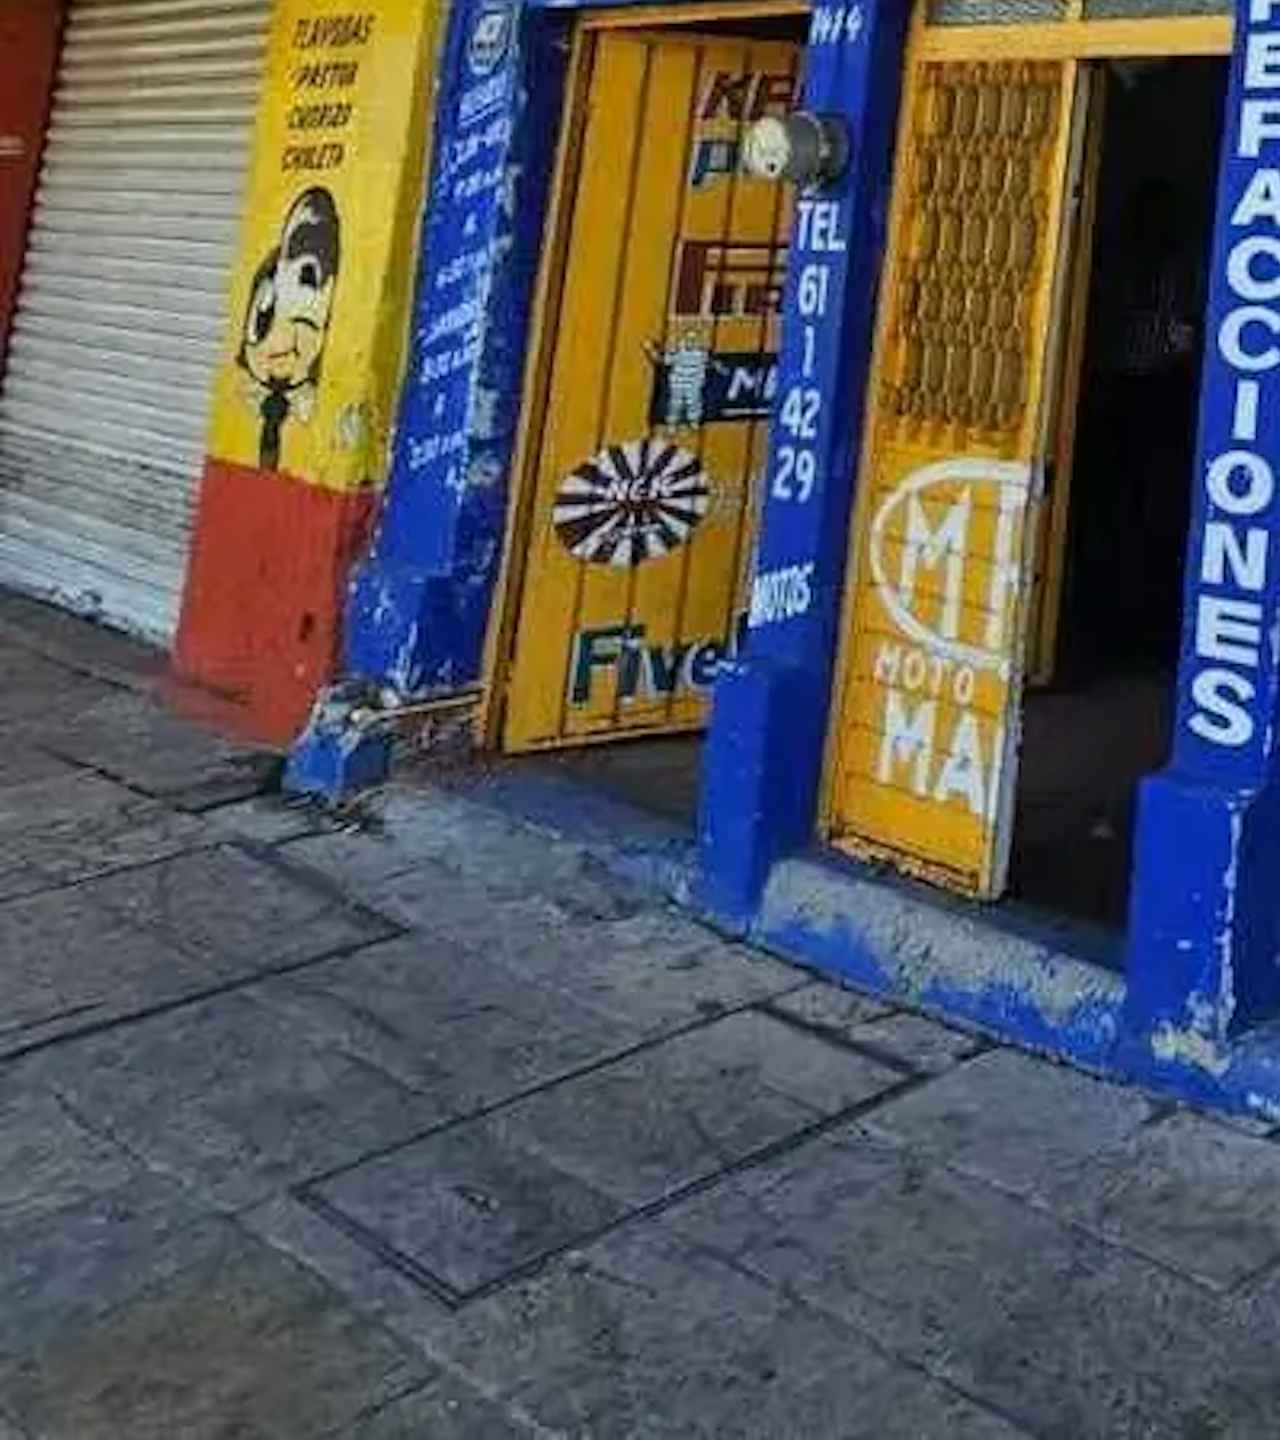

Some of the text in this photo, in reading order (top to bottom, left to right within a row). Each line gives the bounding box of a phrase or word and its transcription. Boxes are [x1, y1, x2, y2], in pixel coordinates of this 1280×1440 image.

[798, 262, 829, 316] 61
[780, 386, 821, 439] 42
[772, 446, 816, 503] 29
